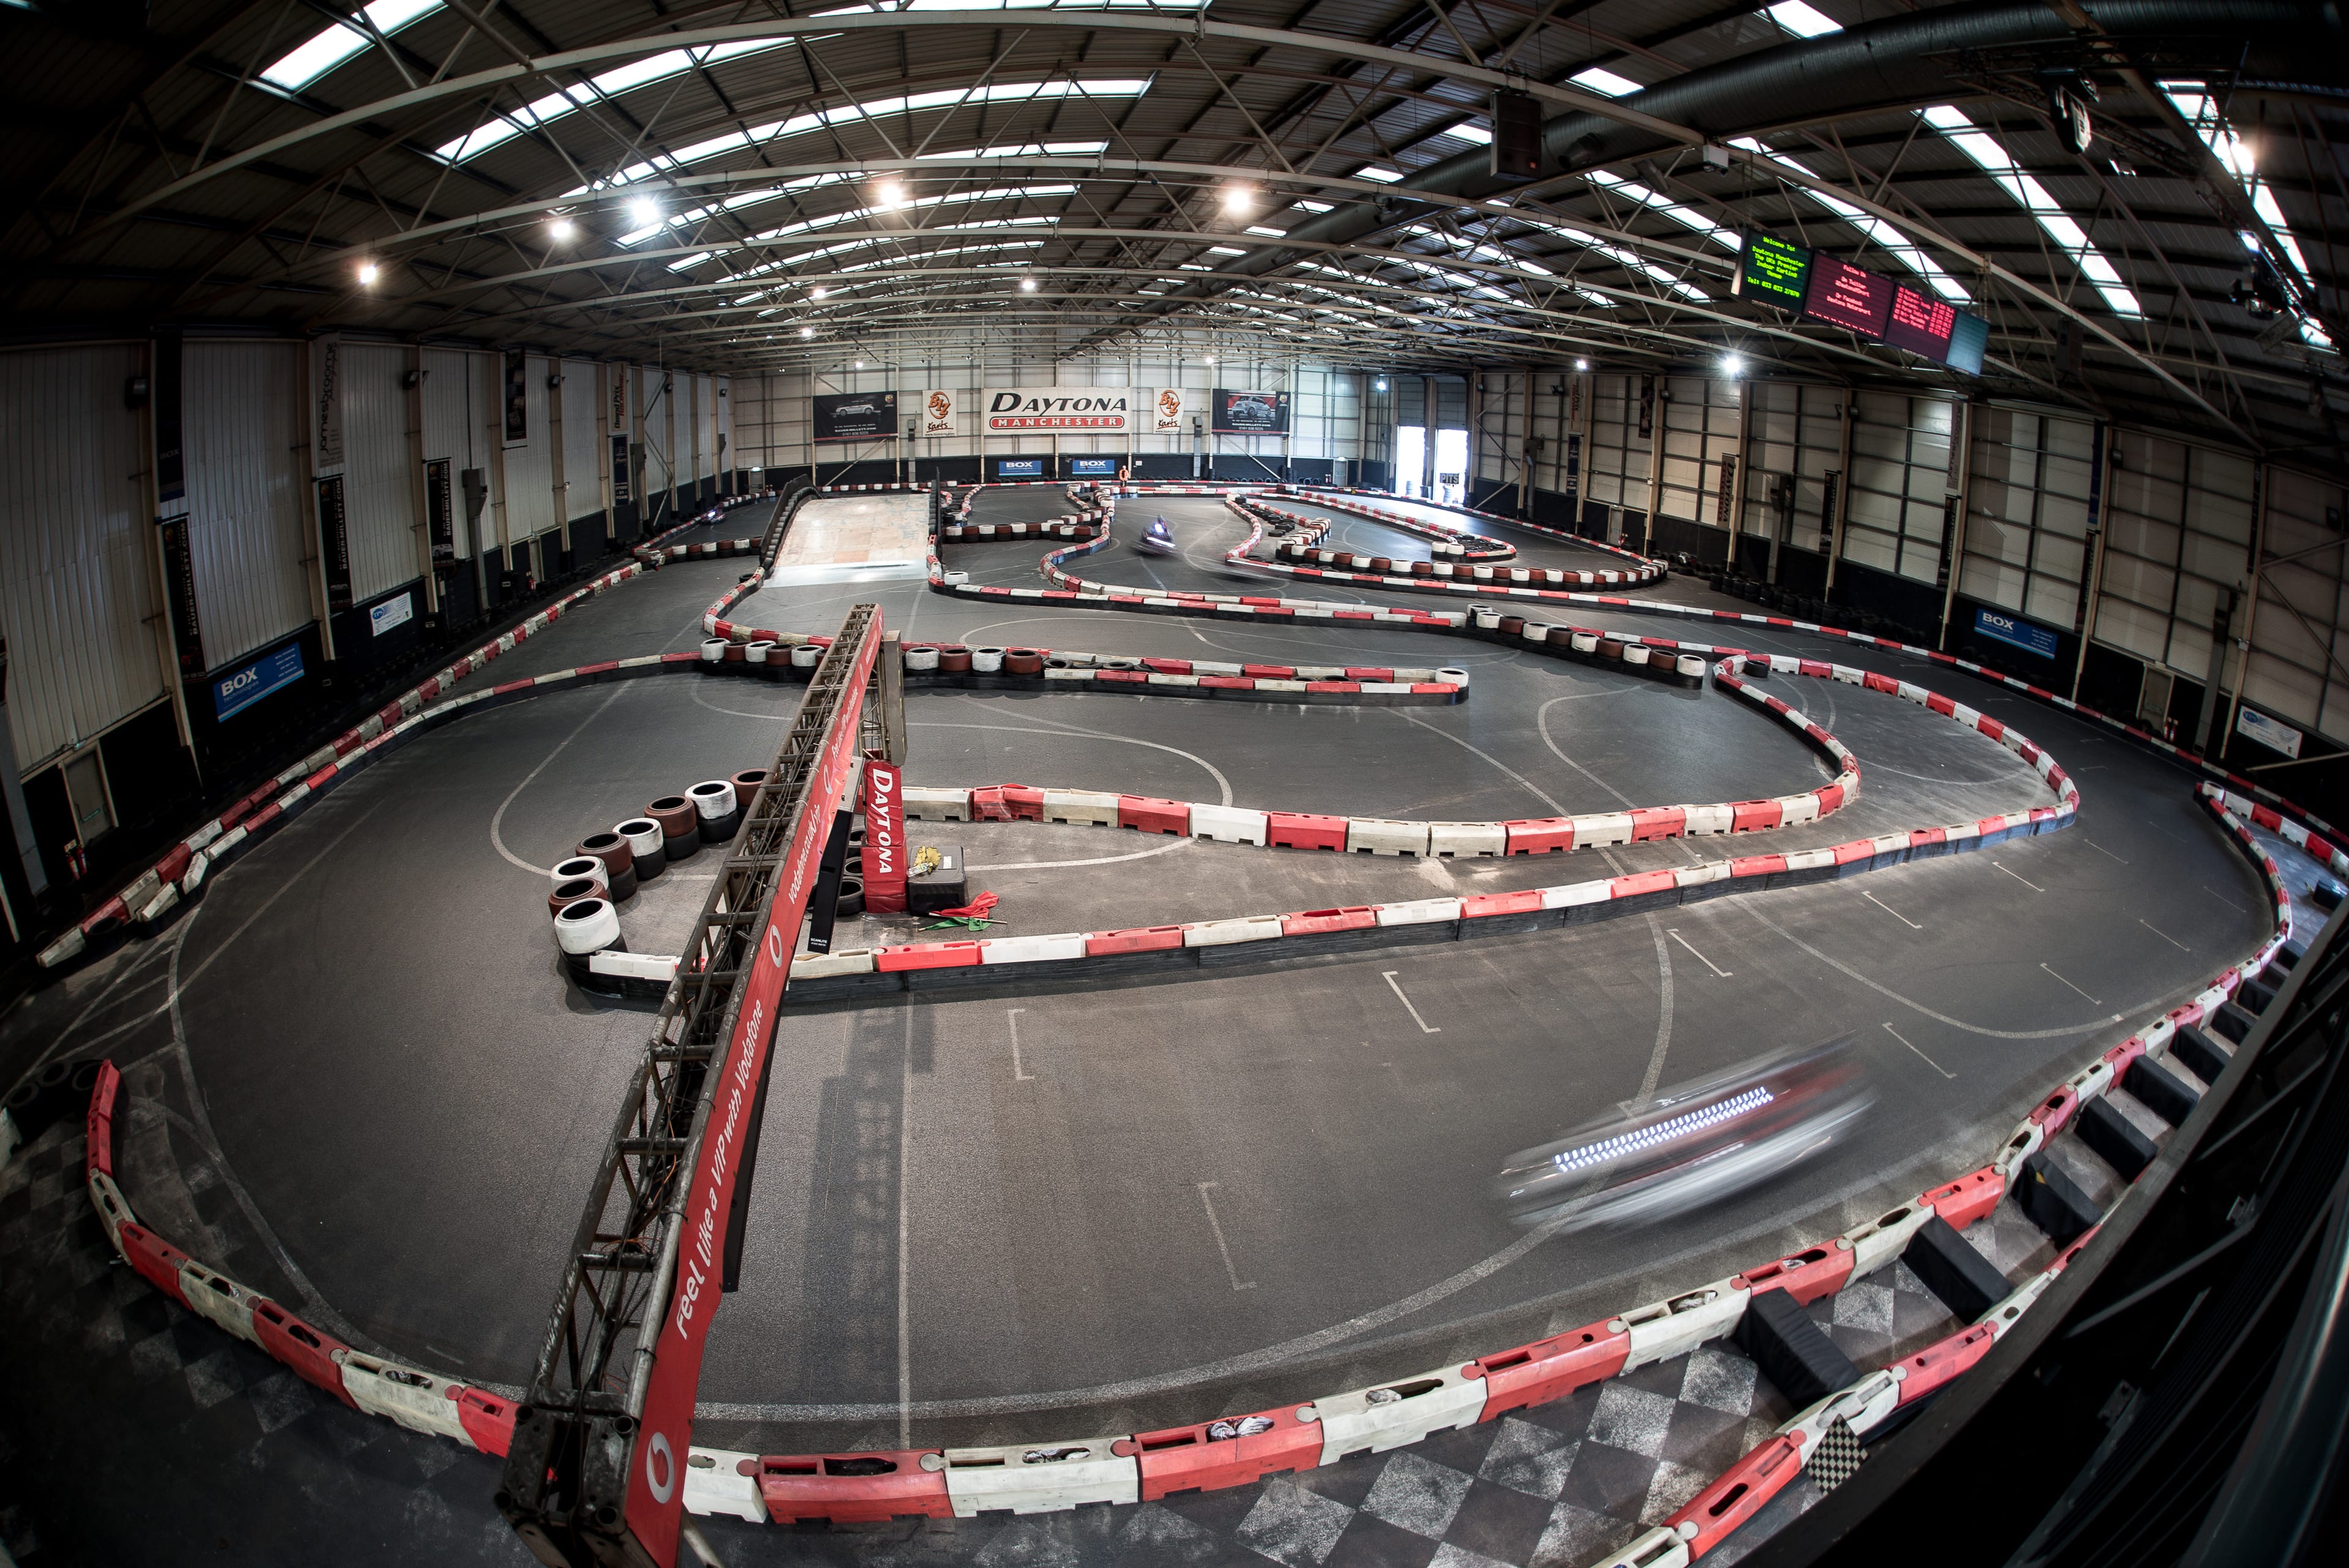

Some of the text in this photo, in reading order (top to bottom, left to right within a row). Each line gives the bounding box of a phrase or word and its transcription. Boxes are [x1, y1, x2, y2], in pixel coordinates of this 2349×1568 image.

[1762, 236, 1785, 248] Welcome
[1752, 245, 1805, 267] Daytona Manchester
[1756, 260, 1775, 270] Indoor
[1777, 261, 1798, 271] Premier
[1747, 276, 1760, 284] Tel:
[928, 395, 951, 415] BIZ
[990, 392, 1127, 417] DAYTONA
[1159, 393, 1181, 414] BIZ
[927, 420, 948, 431] Karts
[1158, 418, 1178, 427] Karts
[1441, 474, 1458, 484] PITS
[1723, 463, 1734, 522] DAYTONA
[1982, 612, 2014, 631] BOX
[220, 667, 258, 697] BOX
[870, 768, 893, 873] DAYTONA
[677, 998, 763, 1340] Feel like a VIP with Vodafone
